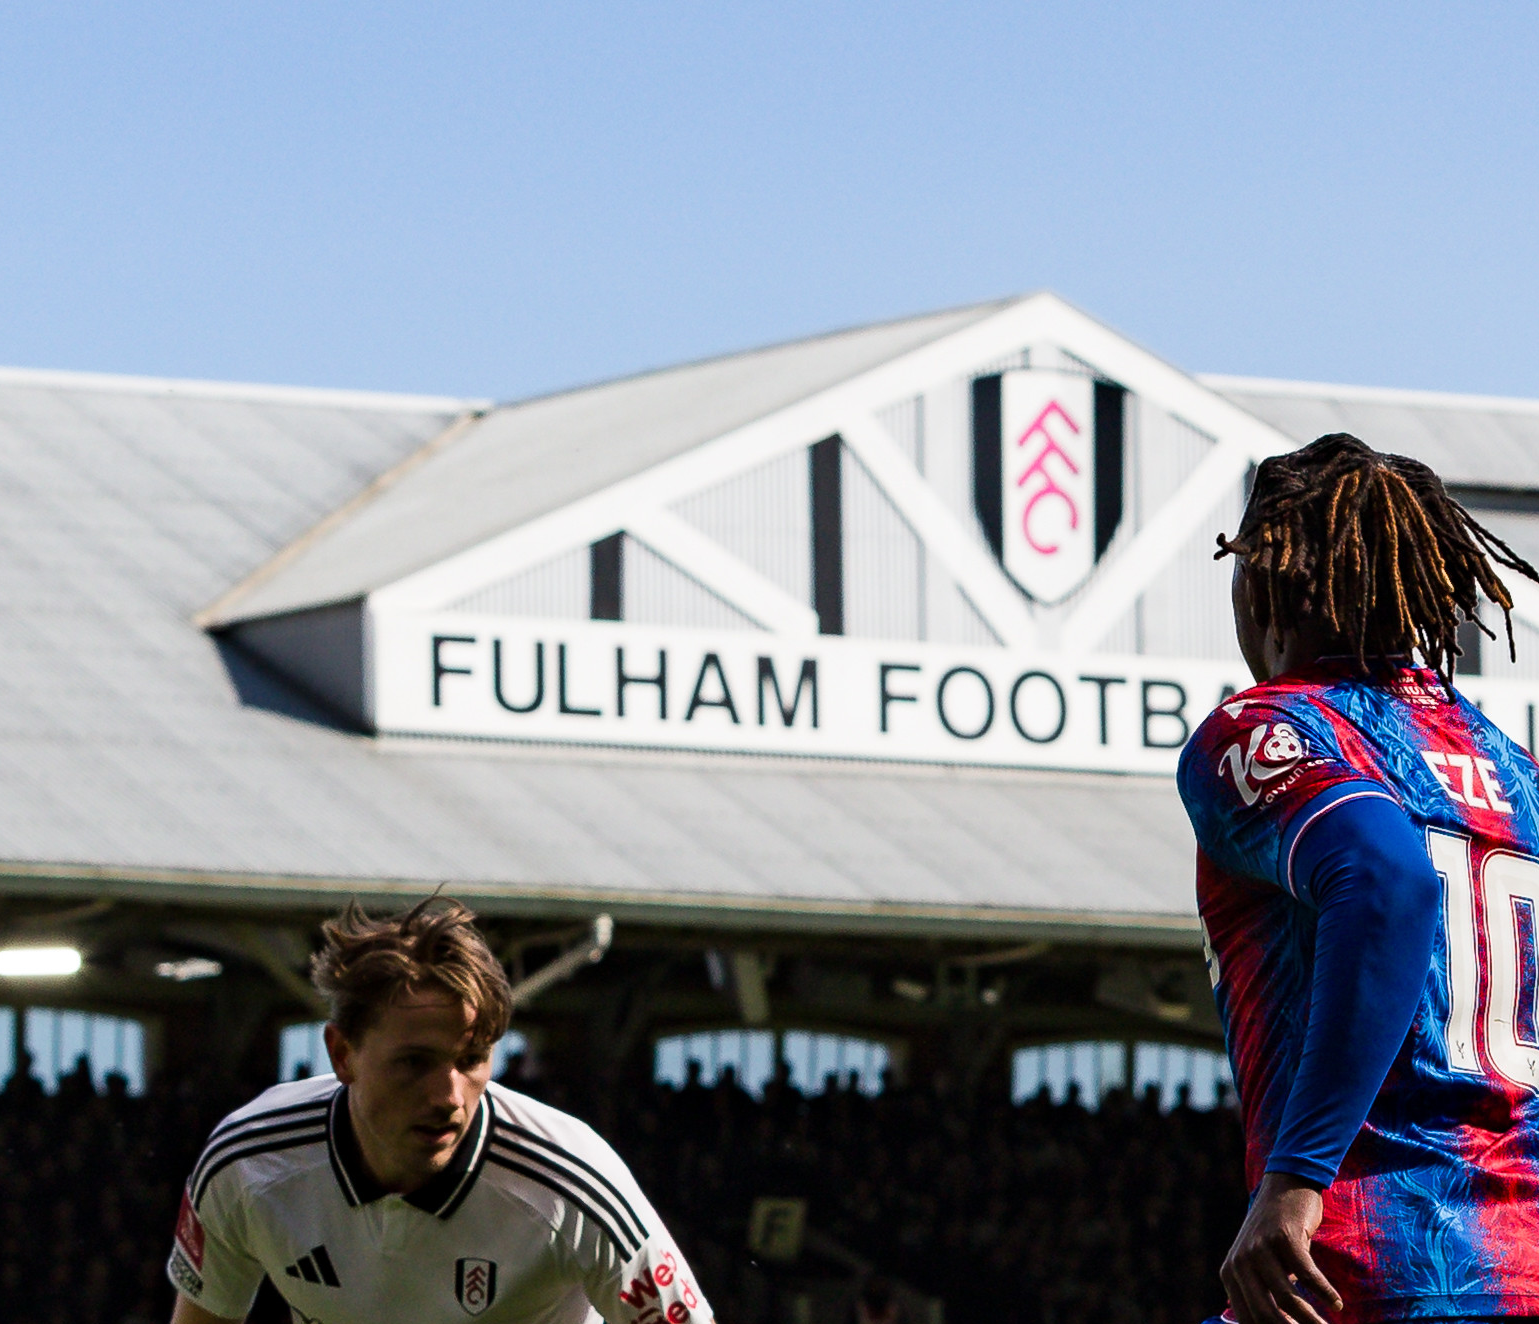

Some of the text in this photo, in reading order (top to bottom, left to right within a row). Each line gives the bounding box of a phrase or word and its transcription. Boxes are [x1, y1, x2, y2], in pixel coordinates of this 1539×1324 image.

[432, 635, 819, 729] FULHAM
[879, 663, 1234, 750] FOOTB
[1420, 750, 1515, 815] EZE
